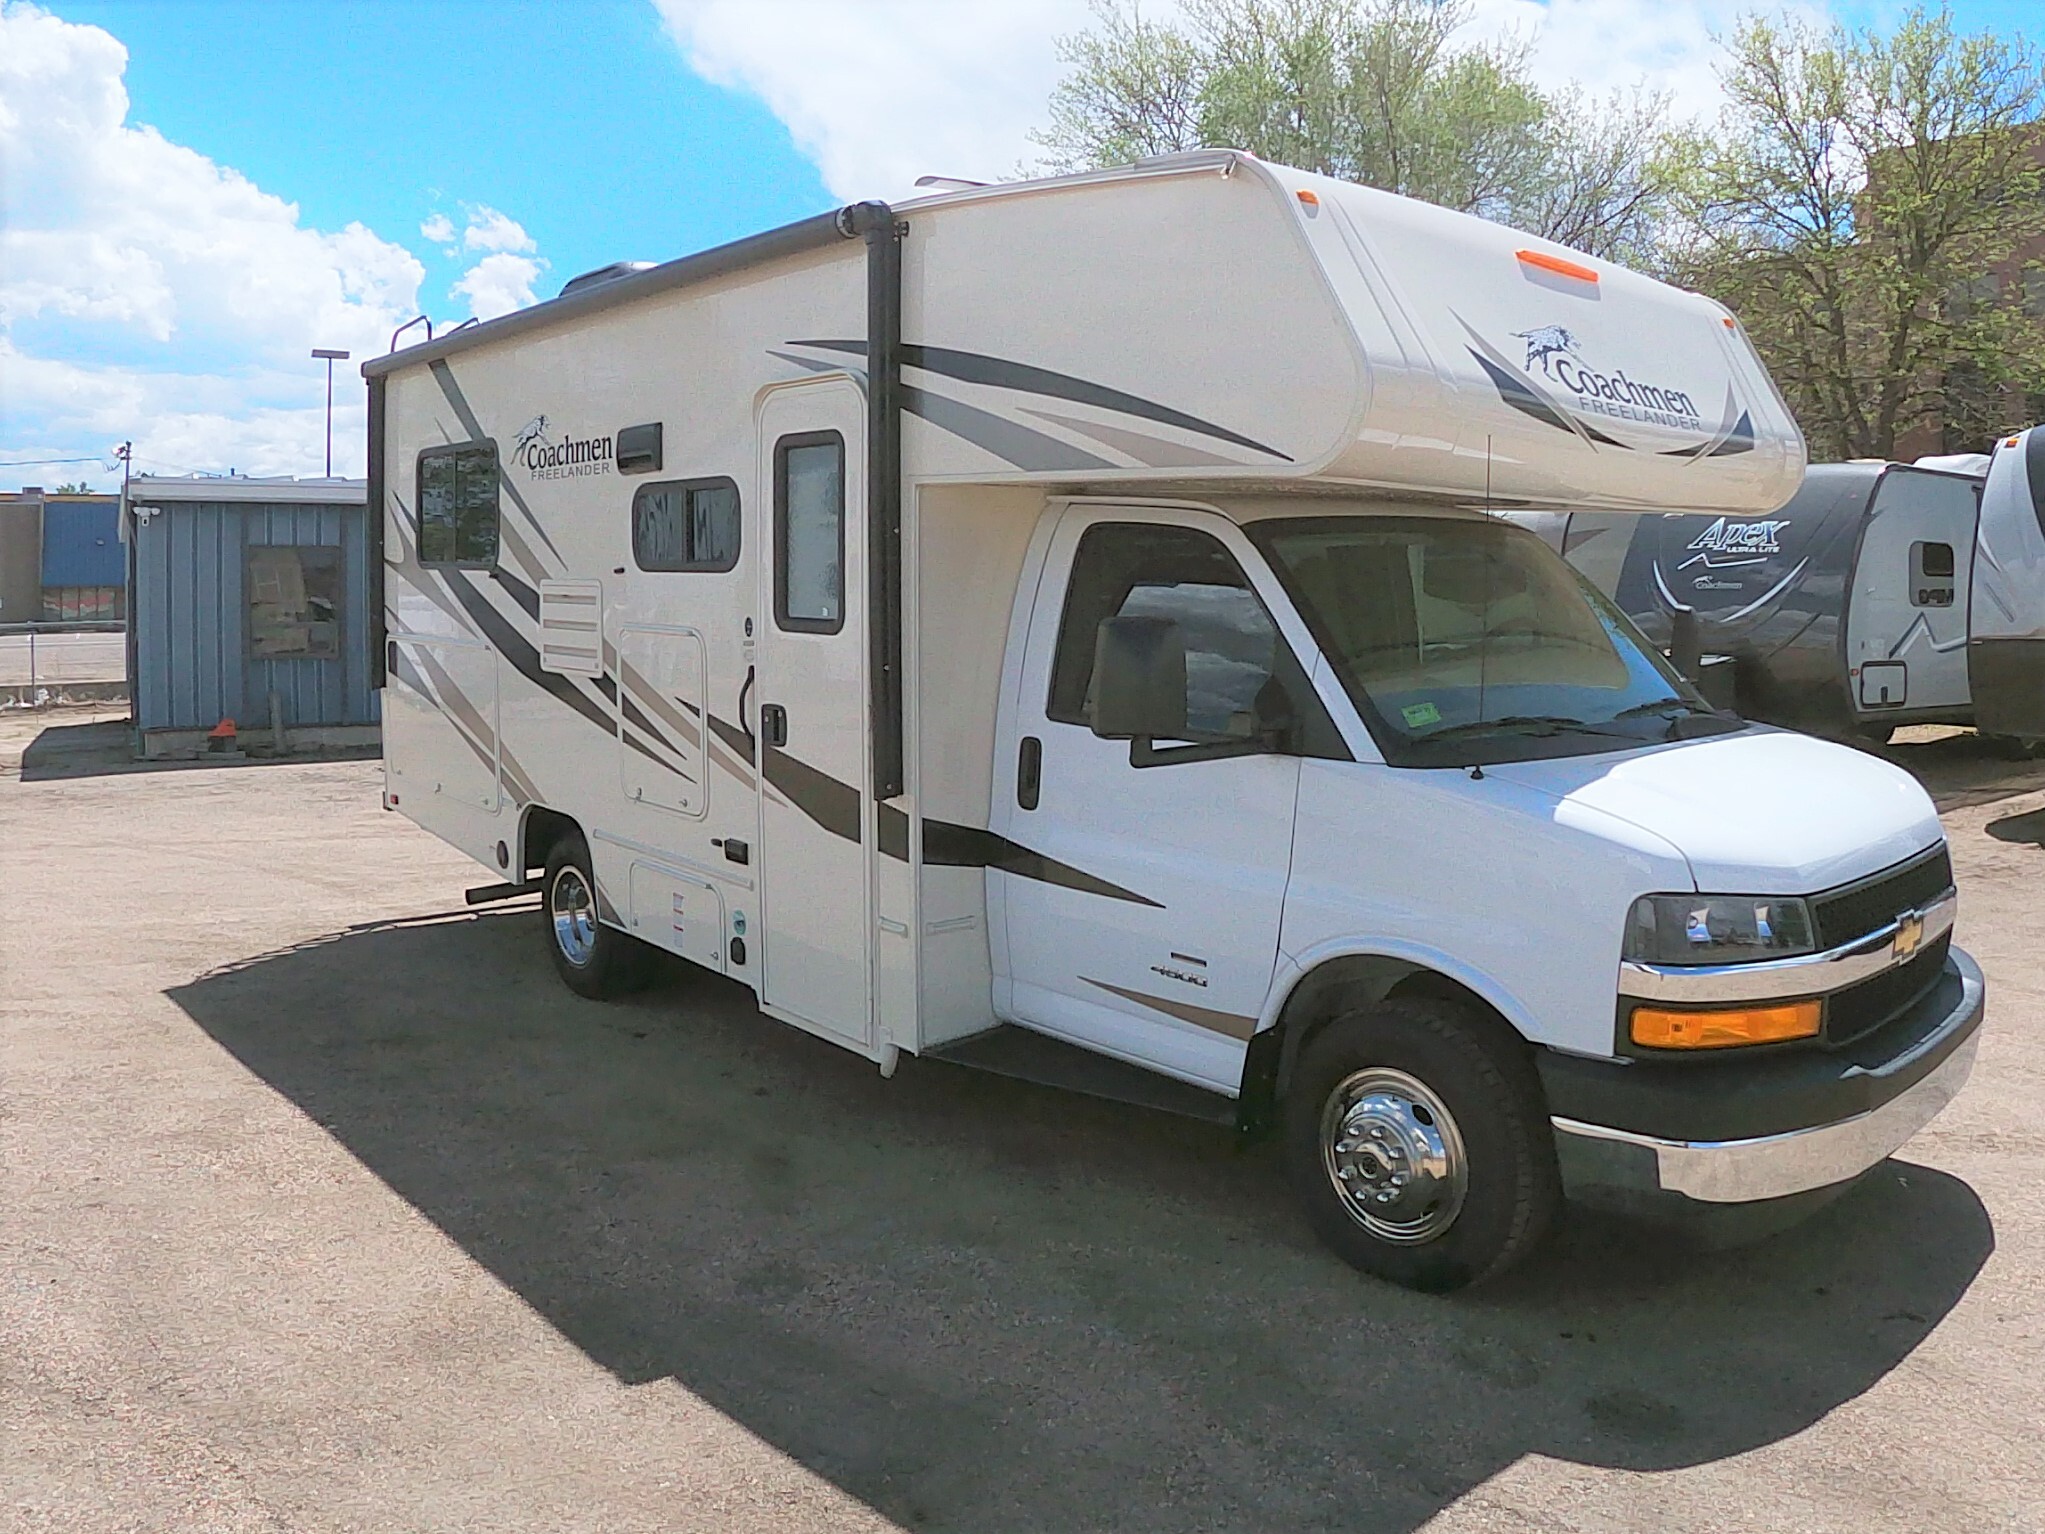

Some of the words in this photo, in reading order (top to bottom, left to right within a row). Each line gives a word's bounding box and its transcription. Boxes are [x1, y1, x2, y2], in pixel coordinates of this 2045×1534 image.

[1555, 359, 1700, 418] Coachmen
[1578, 396, 1701, 432] FREELANDER
[527, 434, 613, 470] Coachmen
[531, 462, 611, 481] FREELANDER
